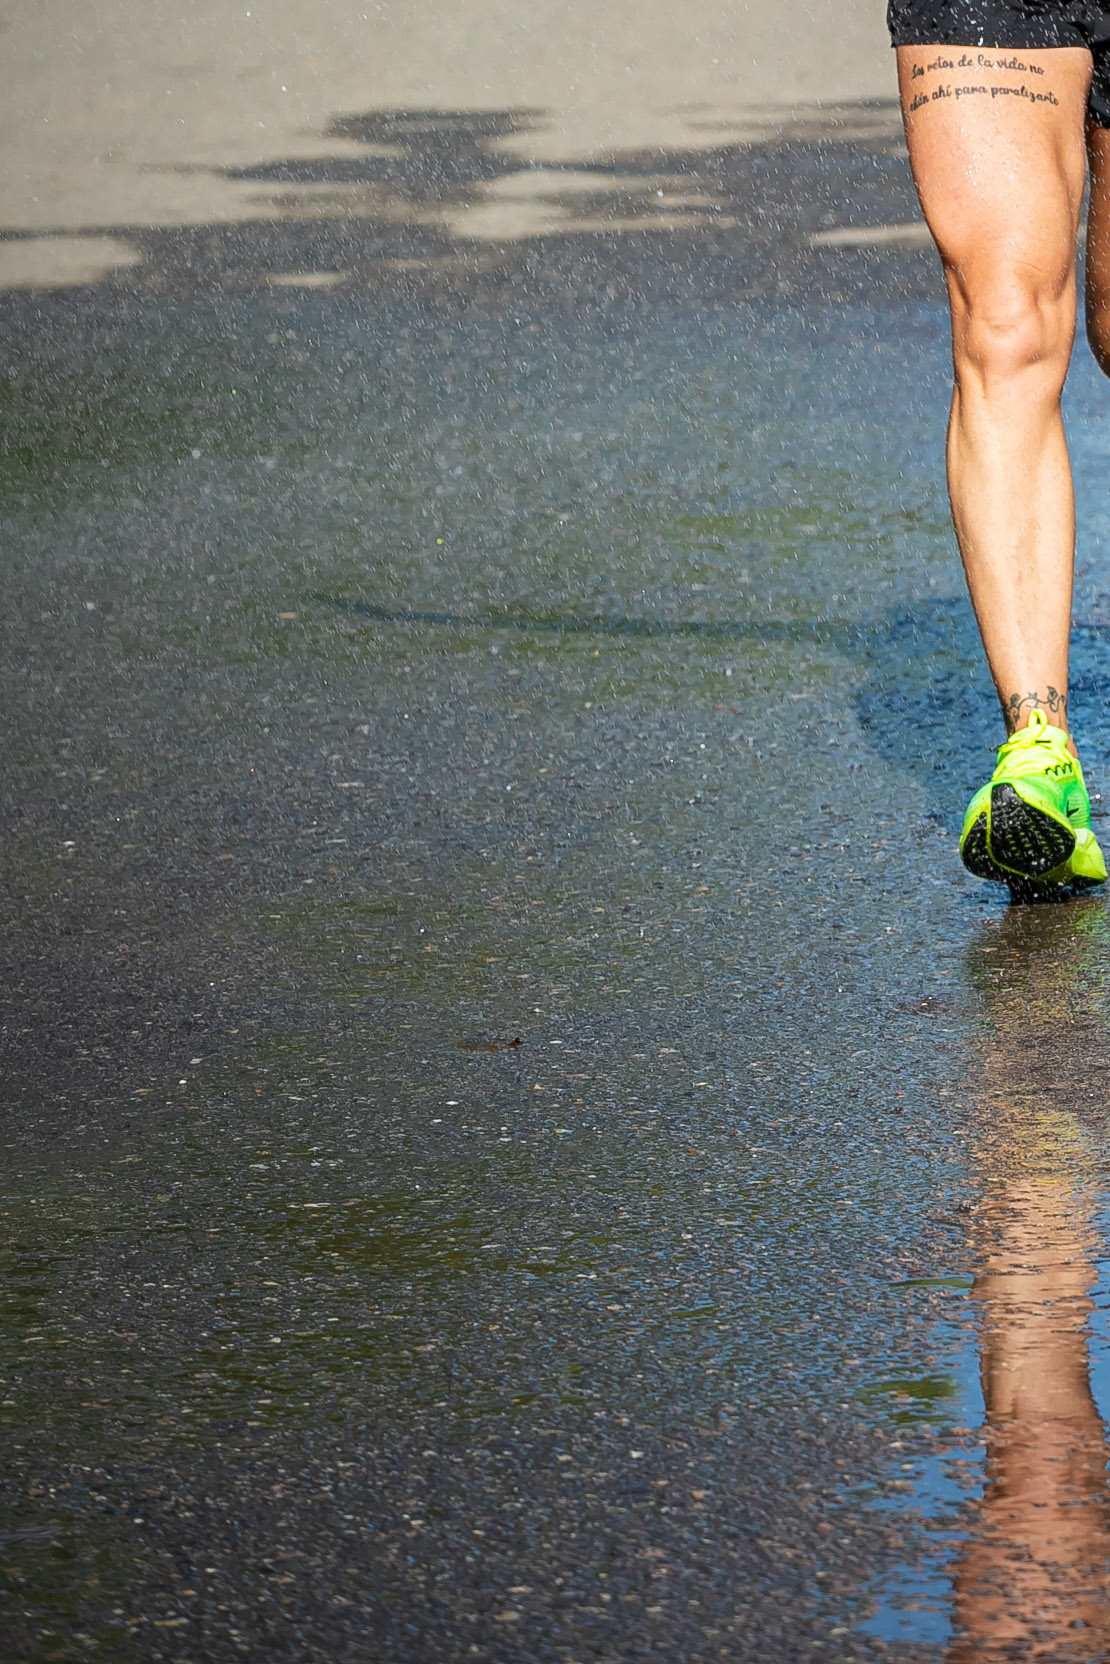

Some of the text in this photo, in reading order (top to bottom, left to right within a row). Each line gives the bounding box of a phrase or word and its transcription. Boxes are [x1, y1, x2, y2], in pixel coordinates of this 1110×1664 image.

[927, 55, 954, 72] retos
[958, 54, 974, 68] de
[977, 54, 995, 68] la
[997, 57, 1028, 72] vida
[1030, 64, 1046, 76] no
[932, 84, 951, 101] ahí
[954, 84, 988, 100] para
[990, 85, 1060, 107] paralizarte
